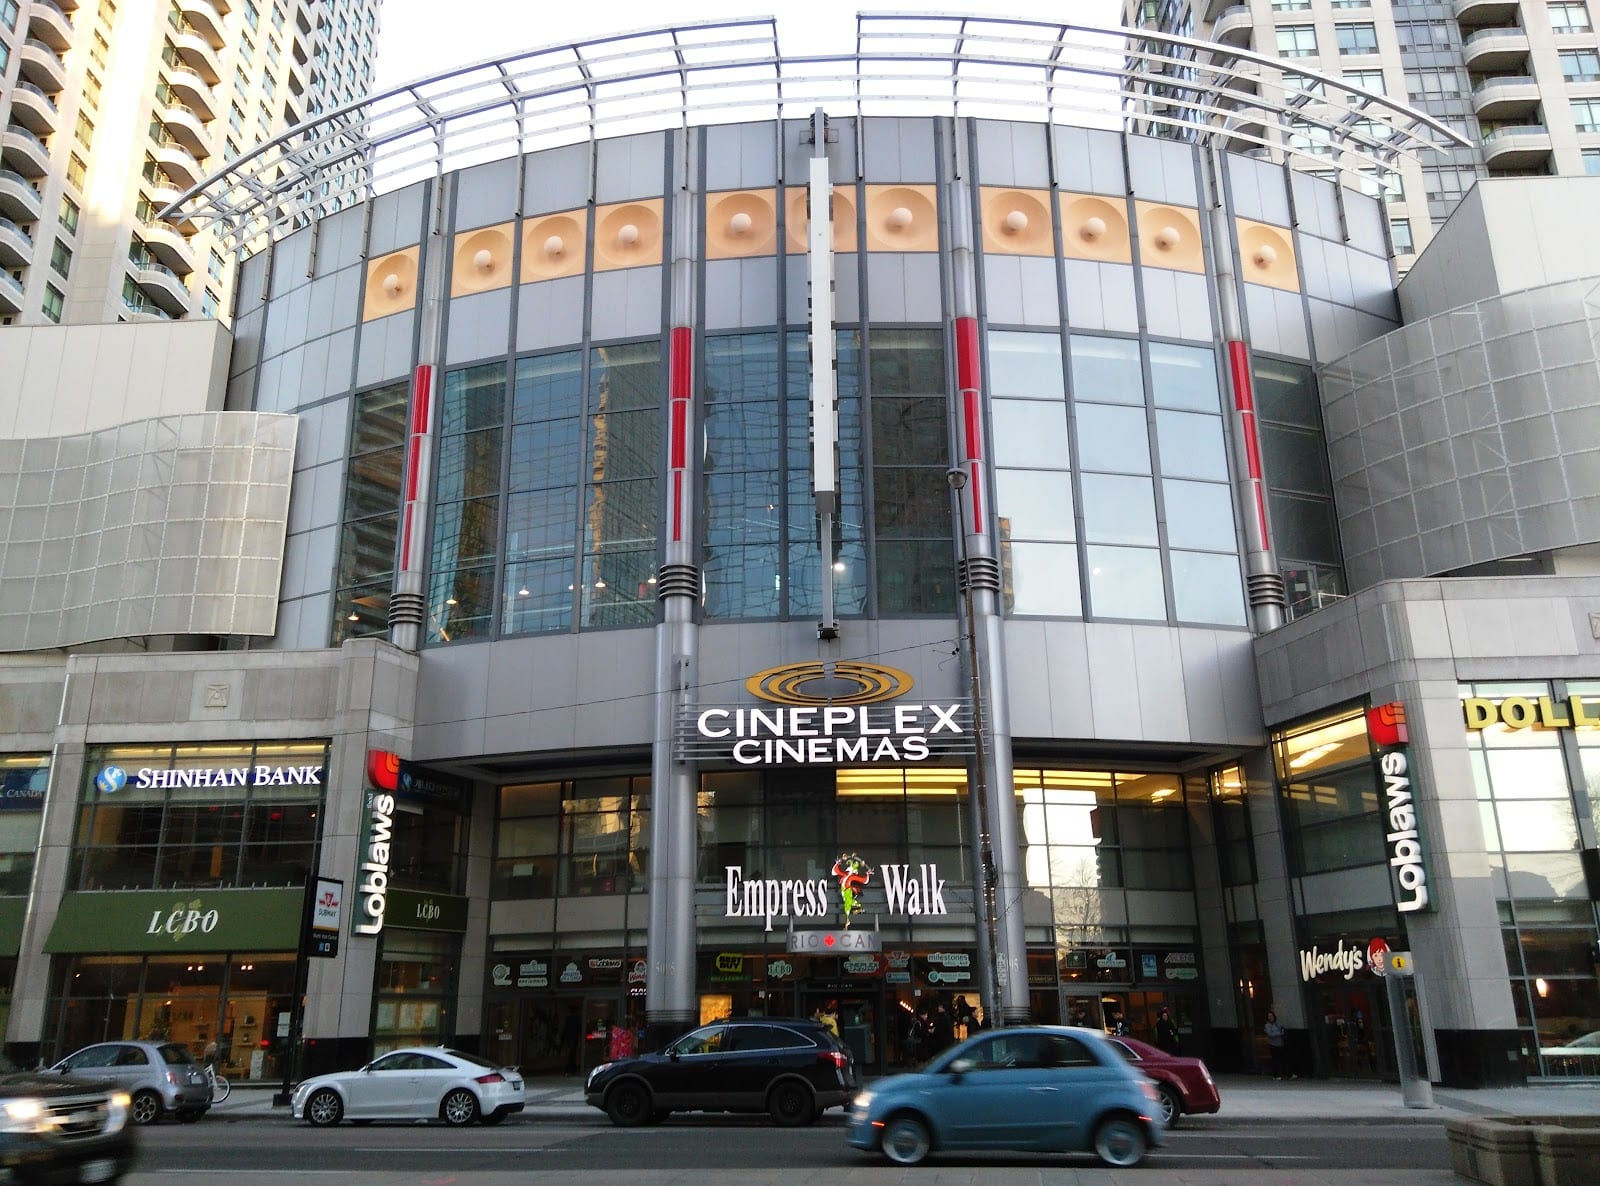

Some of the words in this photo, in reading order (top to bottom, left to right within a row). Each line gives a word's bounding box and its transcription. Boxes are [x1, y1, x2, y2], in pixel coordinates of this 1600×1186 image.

[697, 704, 963, 738] CINEPLEX
[732, 736, 930, 764] CINEMAS
[136, 767, 249, 790] SHINHAN
[253, 765, 322, 787] BANK
[1382, 751, 1427, 913] Loblaws
[356, 794, 395, 936] Loblaws
[725, 866, 828, 931] Empress
[880, 863, 947, 915] Walk
[146, 908, 220, 935] LCBO
[318, 908, 337, 918] SUBWAY
[416, 903, 440, 920] LCBO
[791, 934, 819, 949] RIO
[840, 934, 876, 948] CAN
[767, 963, 793, 976] LCBO
[928, 952, 968, 962] milestones
[1300, 939, 1363, 982] Wendy's
